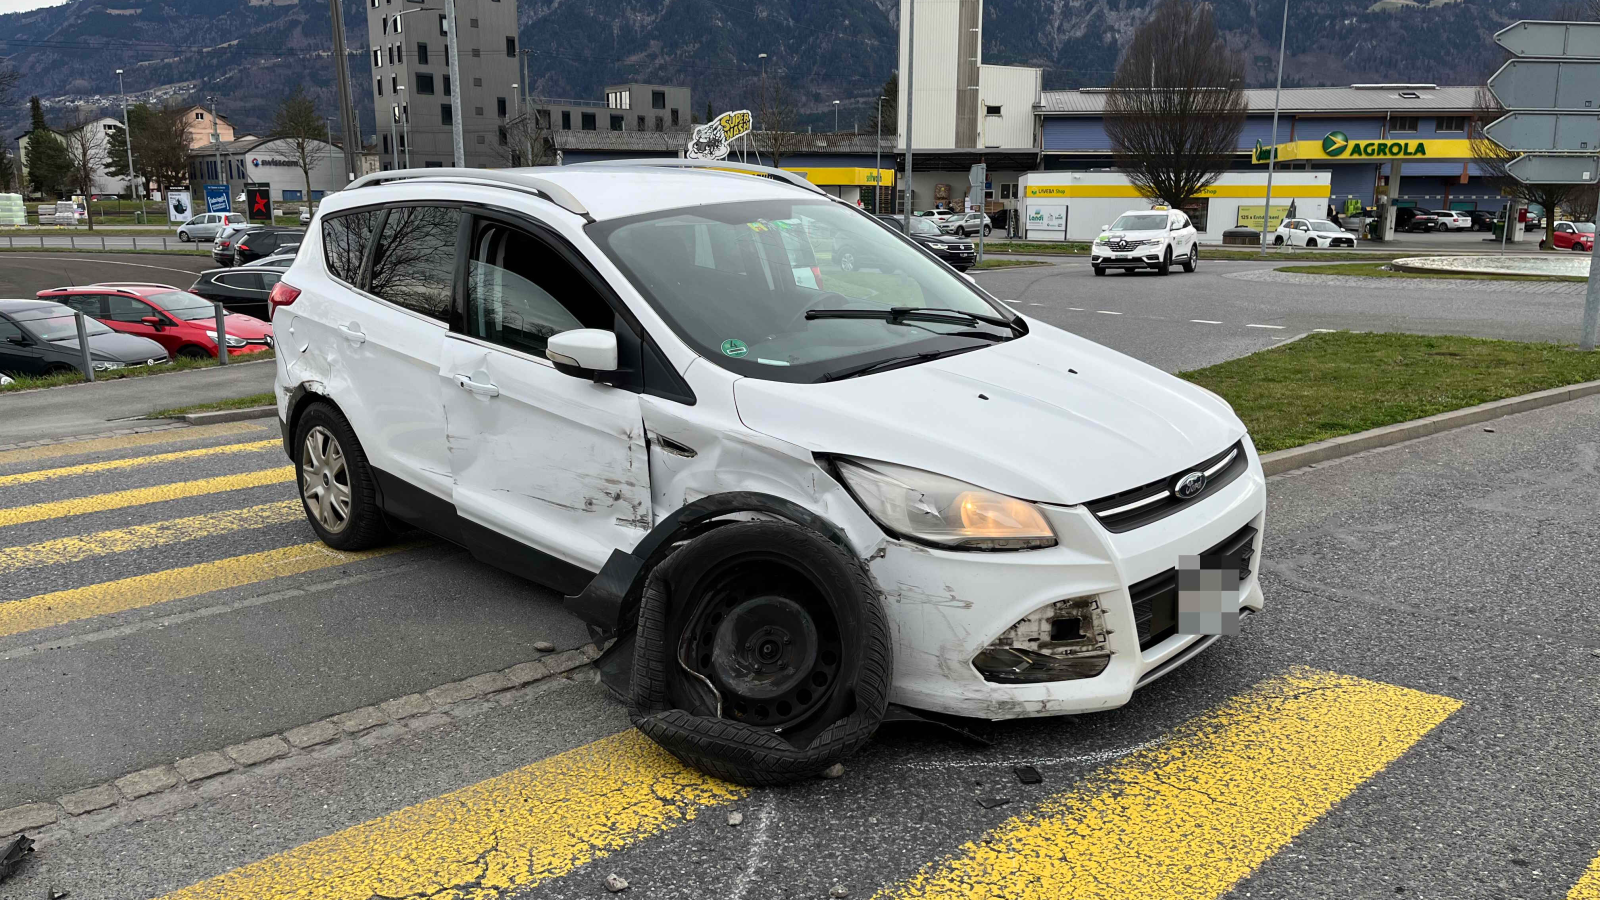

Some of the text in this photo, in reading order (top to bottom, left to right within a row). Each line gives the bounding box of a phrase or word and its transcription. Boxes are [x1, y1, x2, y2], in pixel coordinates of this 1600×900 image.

[720, 112, 750, 131] SUPER
[724, 122, 751, 140] WASH
[1350, 142, 1427, 157] AGROLA
[261, 158, 299, 167] swisscom
